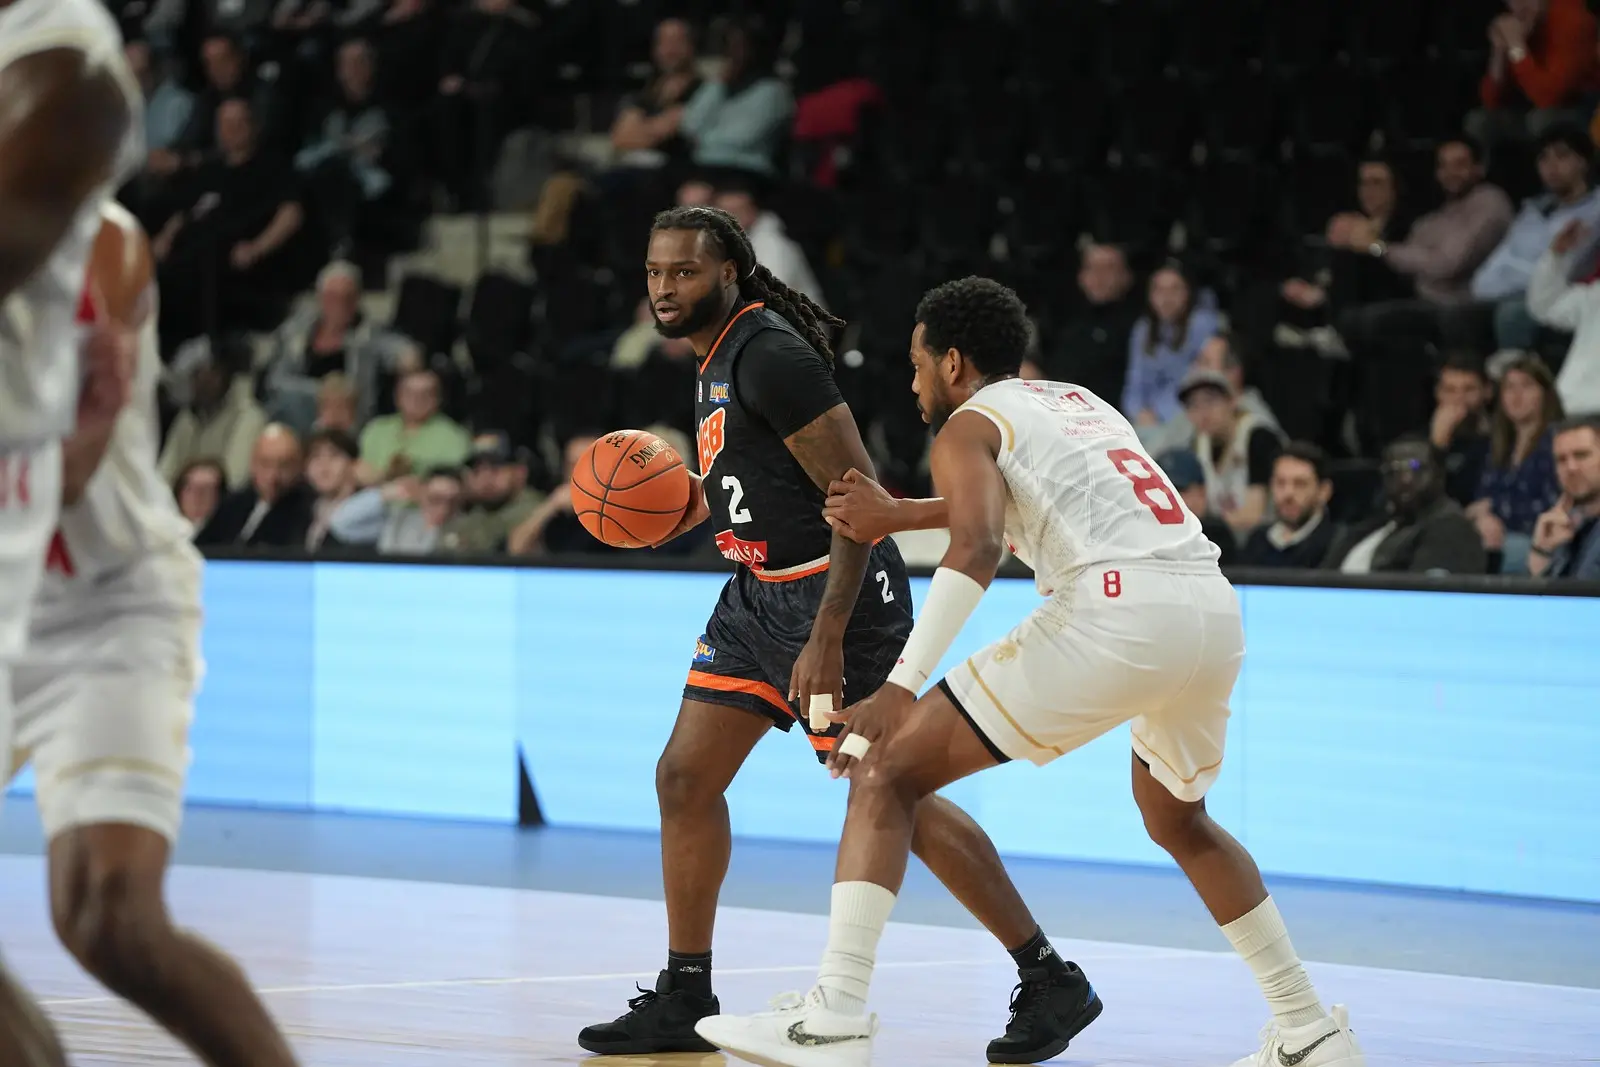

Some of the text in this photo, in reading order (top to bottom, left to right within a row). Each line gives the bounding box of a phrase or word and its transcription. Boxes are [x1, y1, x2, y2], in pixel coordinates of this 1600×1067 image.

[721, 475, 753, 524] 2
[1107, 448, 1185, 525] 8
[875, 570, 895, 604] 2
[1103, 570, 1121, 598] 8
